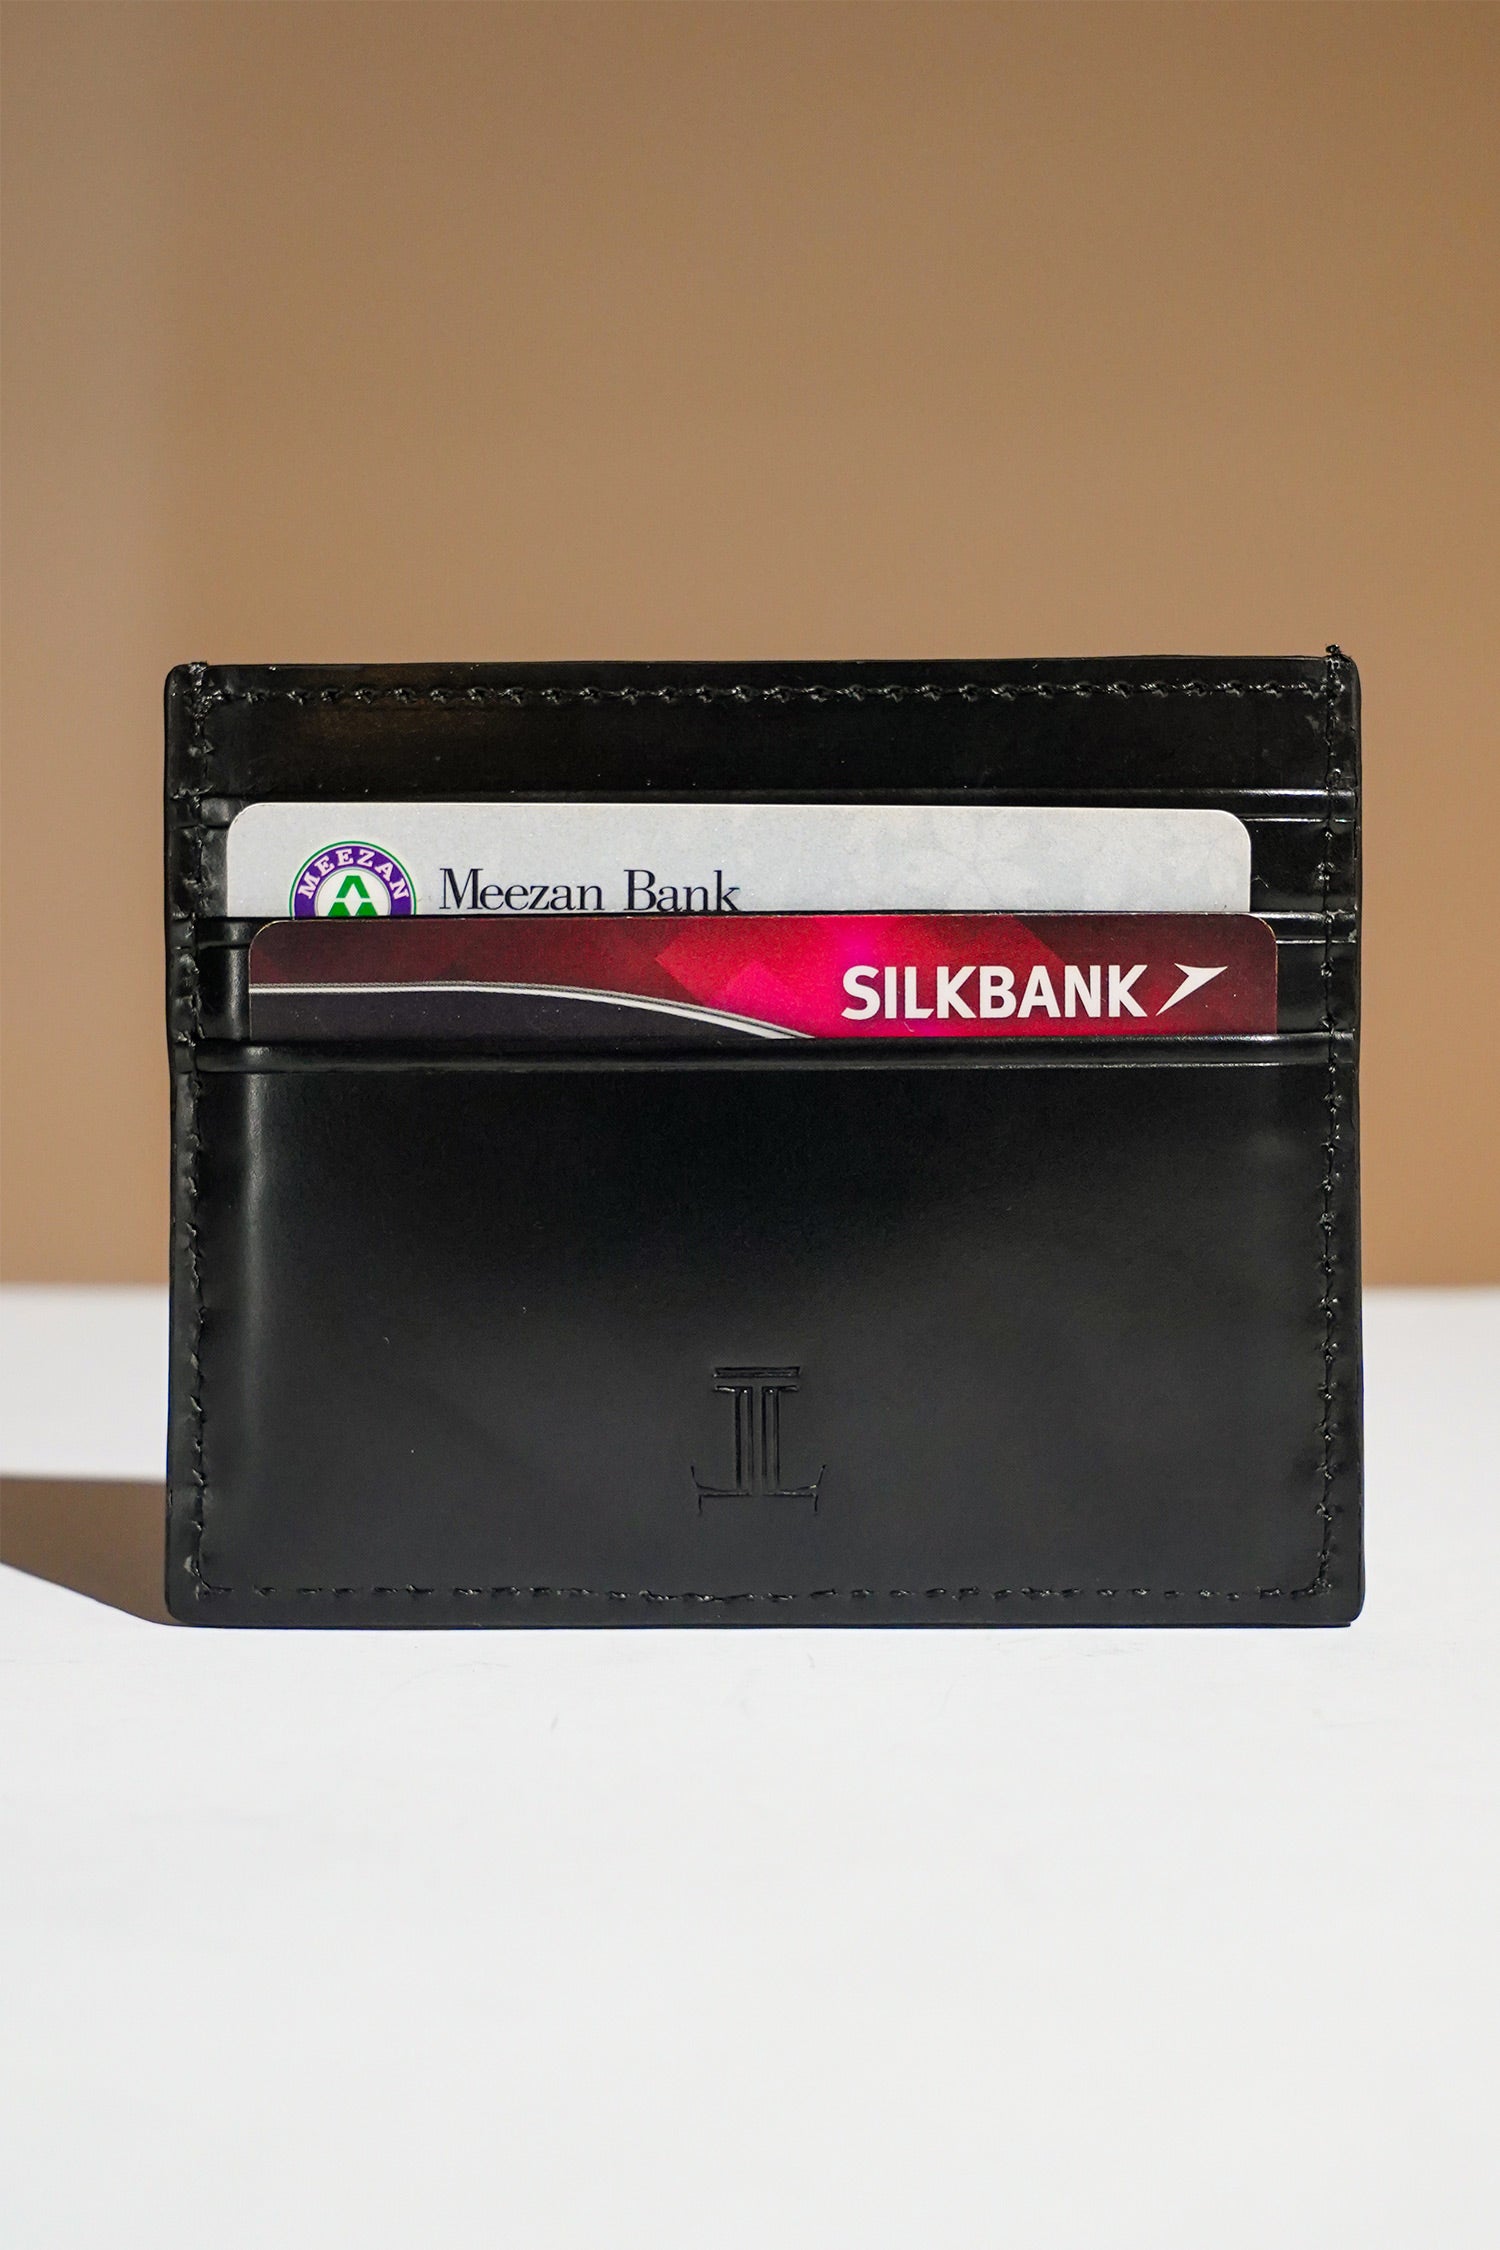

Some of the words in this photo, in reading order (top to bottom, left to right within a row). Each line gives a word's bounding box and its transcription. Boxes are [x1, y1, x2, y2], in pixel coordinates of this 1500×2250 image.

[298, 847, 409, 901] MEEZAN
[439, 867, 605, 911] Meezan
[623, 869, 741, 912] Bank
[841, 964, 1148, 1020] SILKBANK
